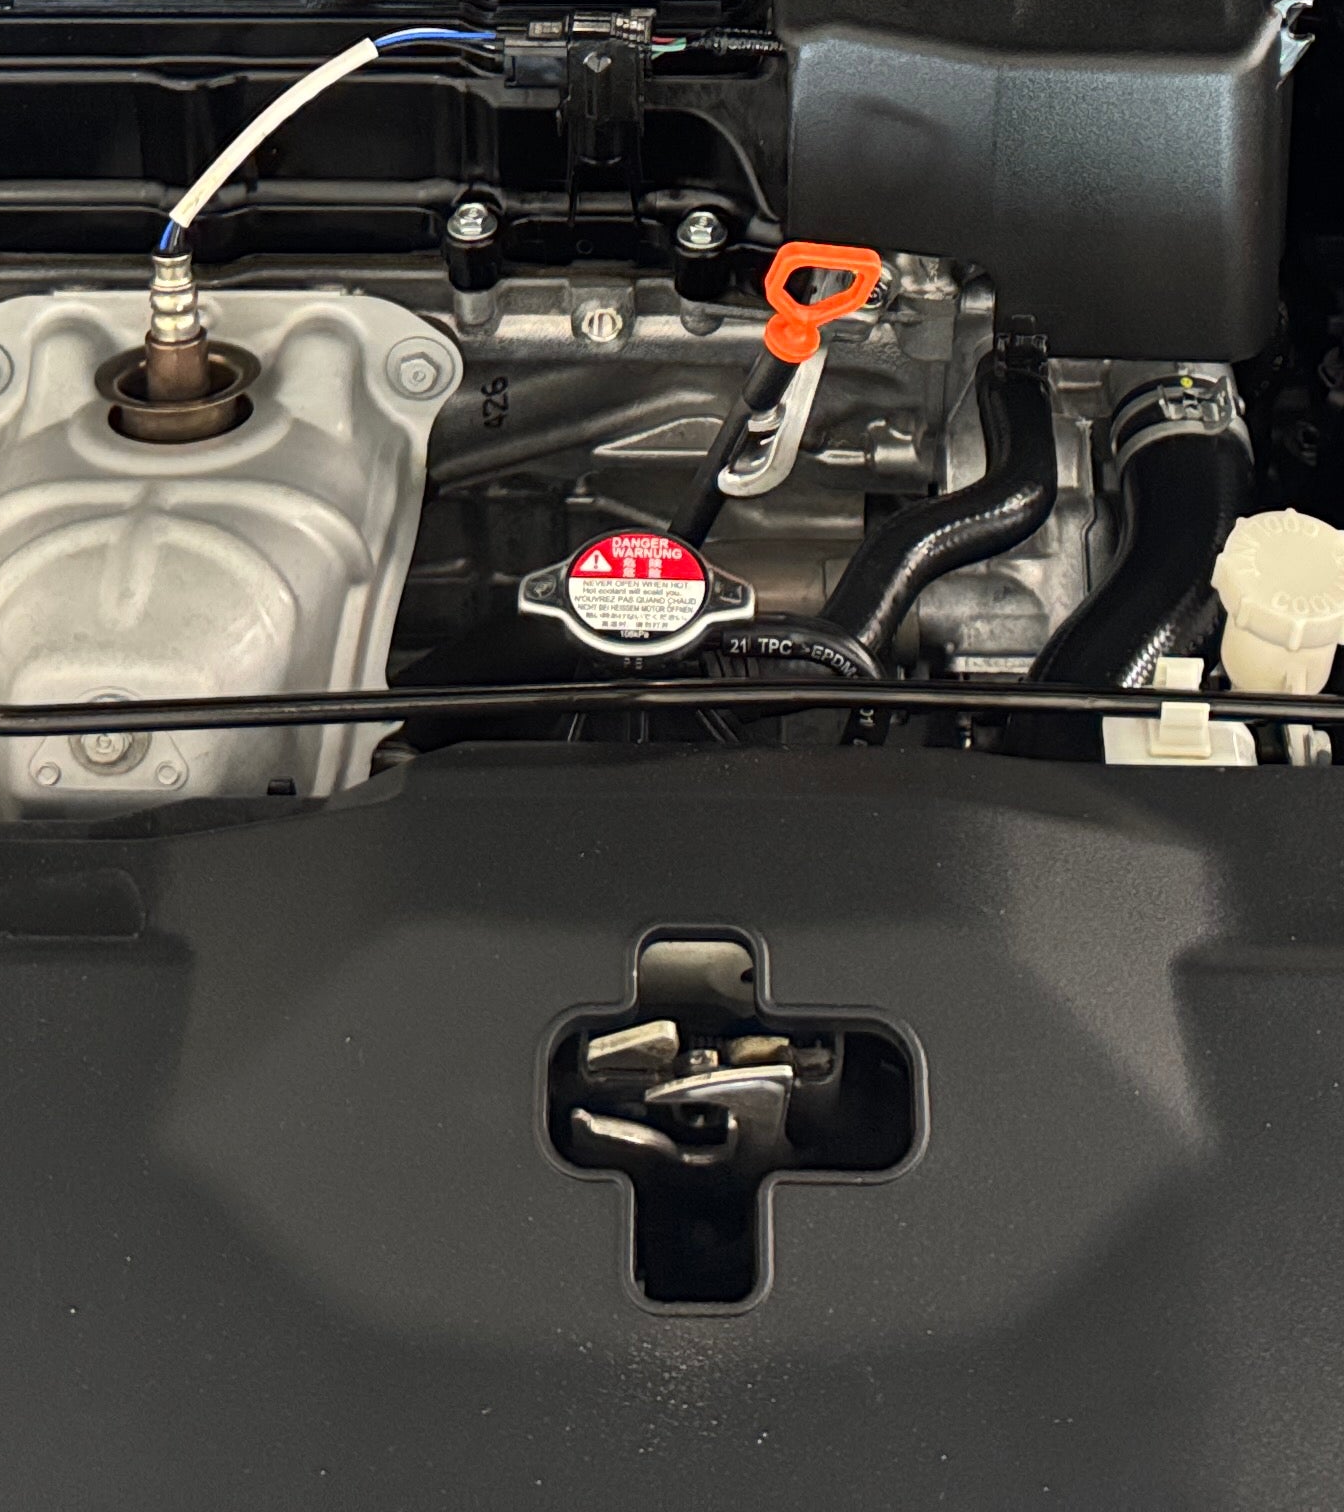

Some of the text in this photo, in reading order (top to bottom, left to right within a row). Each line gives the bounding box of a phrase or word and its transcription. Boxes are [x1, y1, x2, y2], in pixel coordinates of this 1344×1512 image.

[611, 537, 669, 549] DANGER
[611, 548, 683, 560] WARNUNG
[615, 580, 640, 588] OPEN
[670, 581, 689, 589] HOT
[757, 637, 793, 656] TPC
